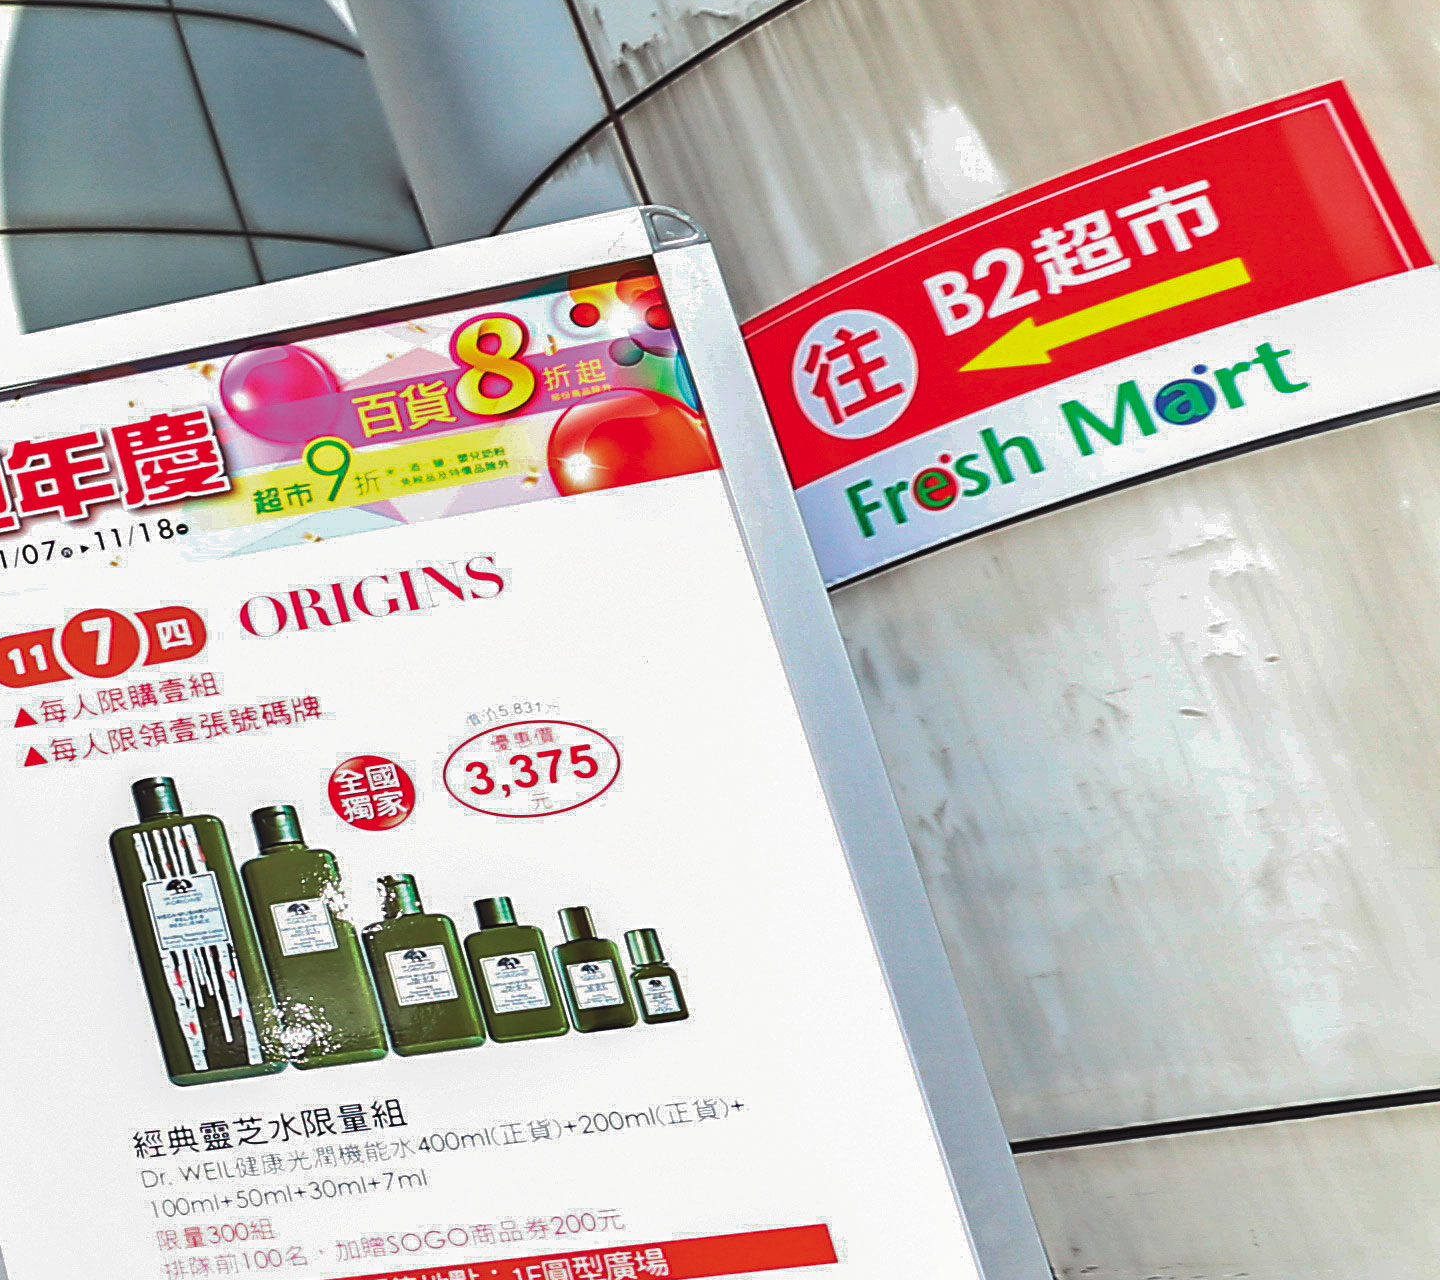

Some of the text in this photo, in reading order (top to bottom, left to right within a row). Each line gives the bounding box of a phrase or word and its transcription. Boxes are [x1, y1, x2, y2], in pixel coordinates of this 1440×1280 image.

[923, 178, 1220, 337] B2超市
[803, 323, 906, 426] 往
[844, 341, 1310, 539] Fresh Mart
[238, 555, 506, 639] ORIGINS
[38, 671, 222, 725] 每人限購壹組
[49, 694, 324, 764] 每人限領壹張號碼牌
[333, 762, 402, 794] 全國
[464, 743, 599, 799] 3,375
[340, 786, 407, 823] 獨家
[132, 1097, 409, 1161] 經典靈芝水限量組
[140, 1165, 175, 1190] Dr.
[149, 1166, 430, 1219] 100ml+50ml+30ml+7ml
[155, 1217, 275, 1254] 限量300組
